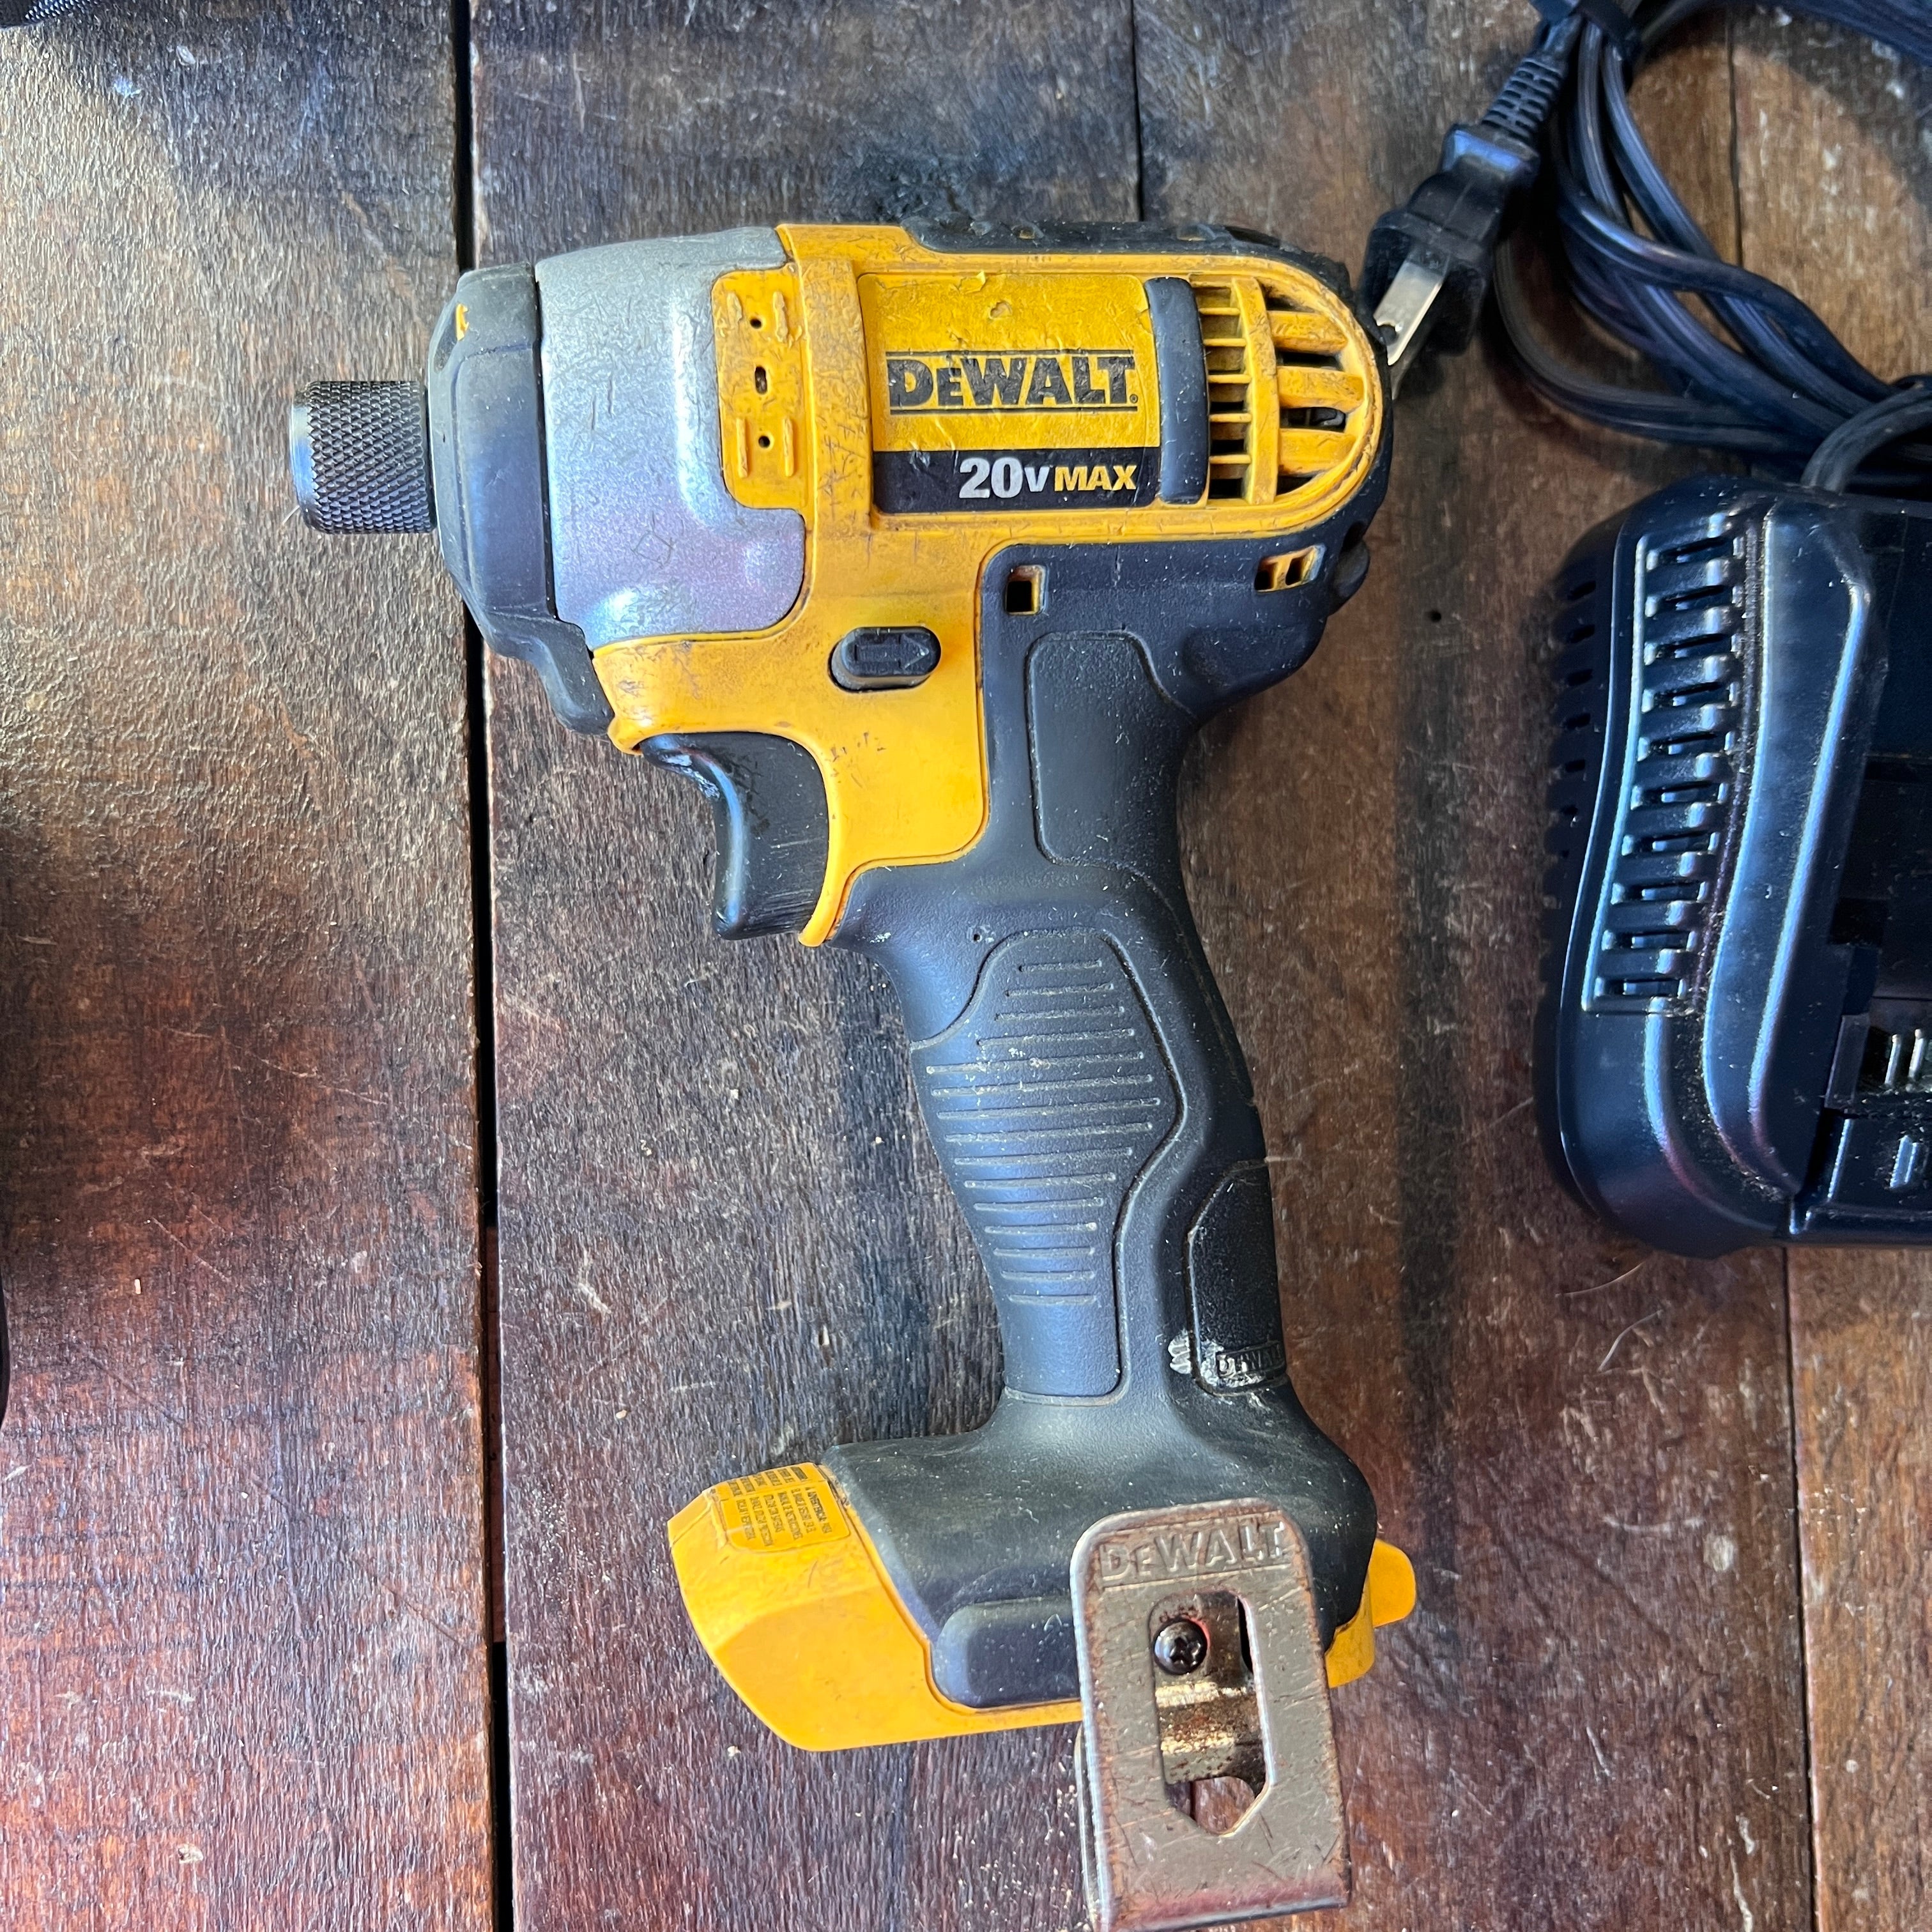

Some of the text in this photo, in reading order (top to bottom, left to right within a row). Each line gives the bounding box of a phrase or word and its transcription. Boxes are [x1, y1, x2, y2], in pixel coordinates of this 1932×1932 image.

[887, 356, 1135, 407] DEWALT
[1054, 465, 1137, 491] MAX
[1099, 1520, 1286, 1582] DEWALT
